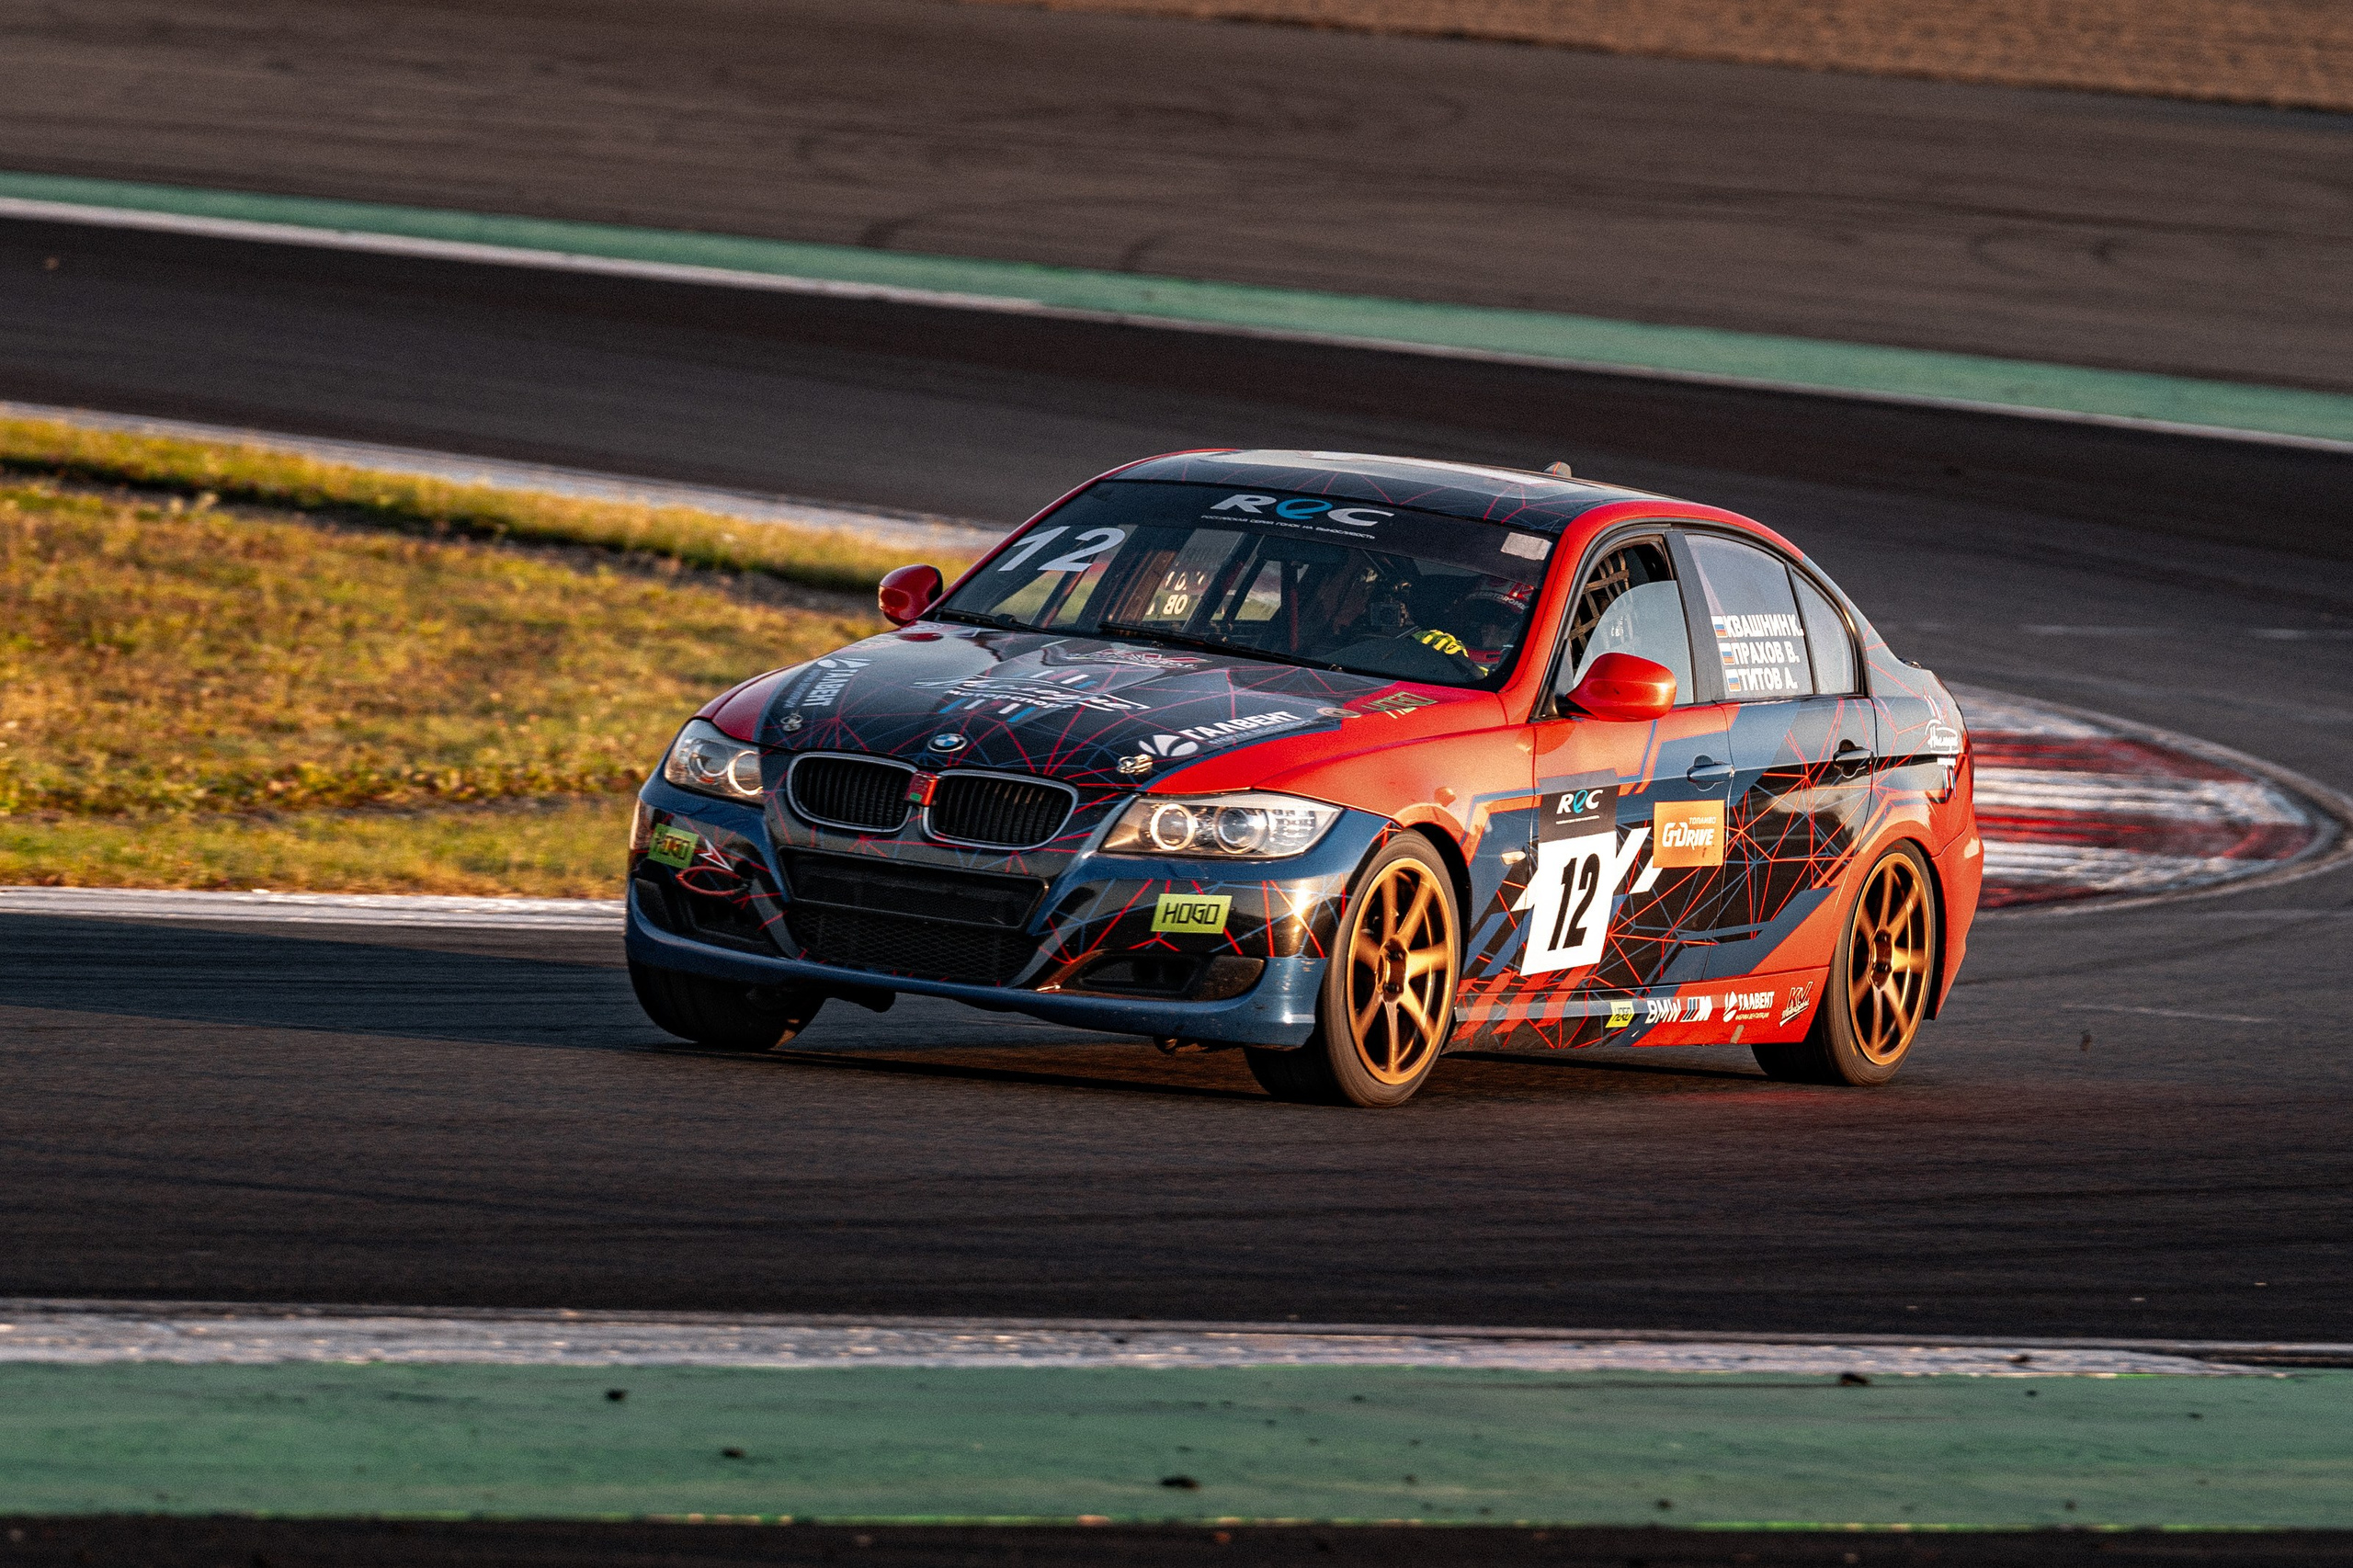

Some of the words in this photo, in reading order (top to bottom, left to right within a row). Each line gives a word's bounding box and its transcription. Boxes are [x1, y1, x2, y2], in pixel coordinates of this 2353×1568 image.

[997, 526, 1126, 572] 12
[1722, 614, 1790, 638] КВАШНИН
[1731, 641, 1784, 665] ПРАХОВ
[1737, 667, 1782, 691] ТИТОВ
[1179, 710, 1302, 741] ГАЛВЕНТ
[1162, 902, 1221, 925] HOGO
[1547, 853, 1600, 951] 12
[1644, 998, 1682, 1024] BMW
